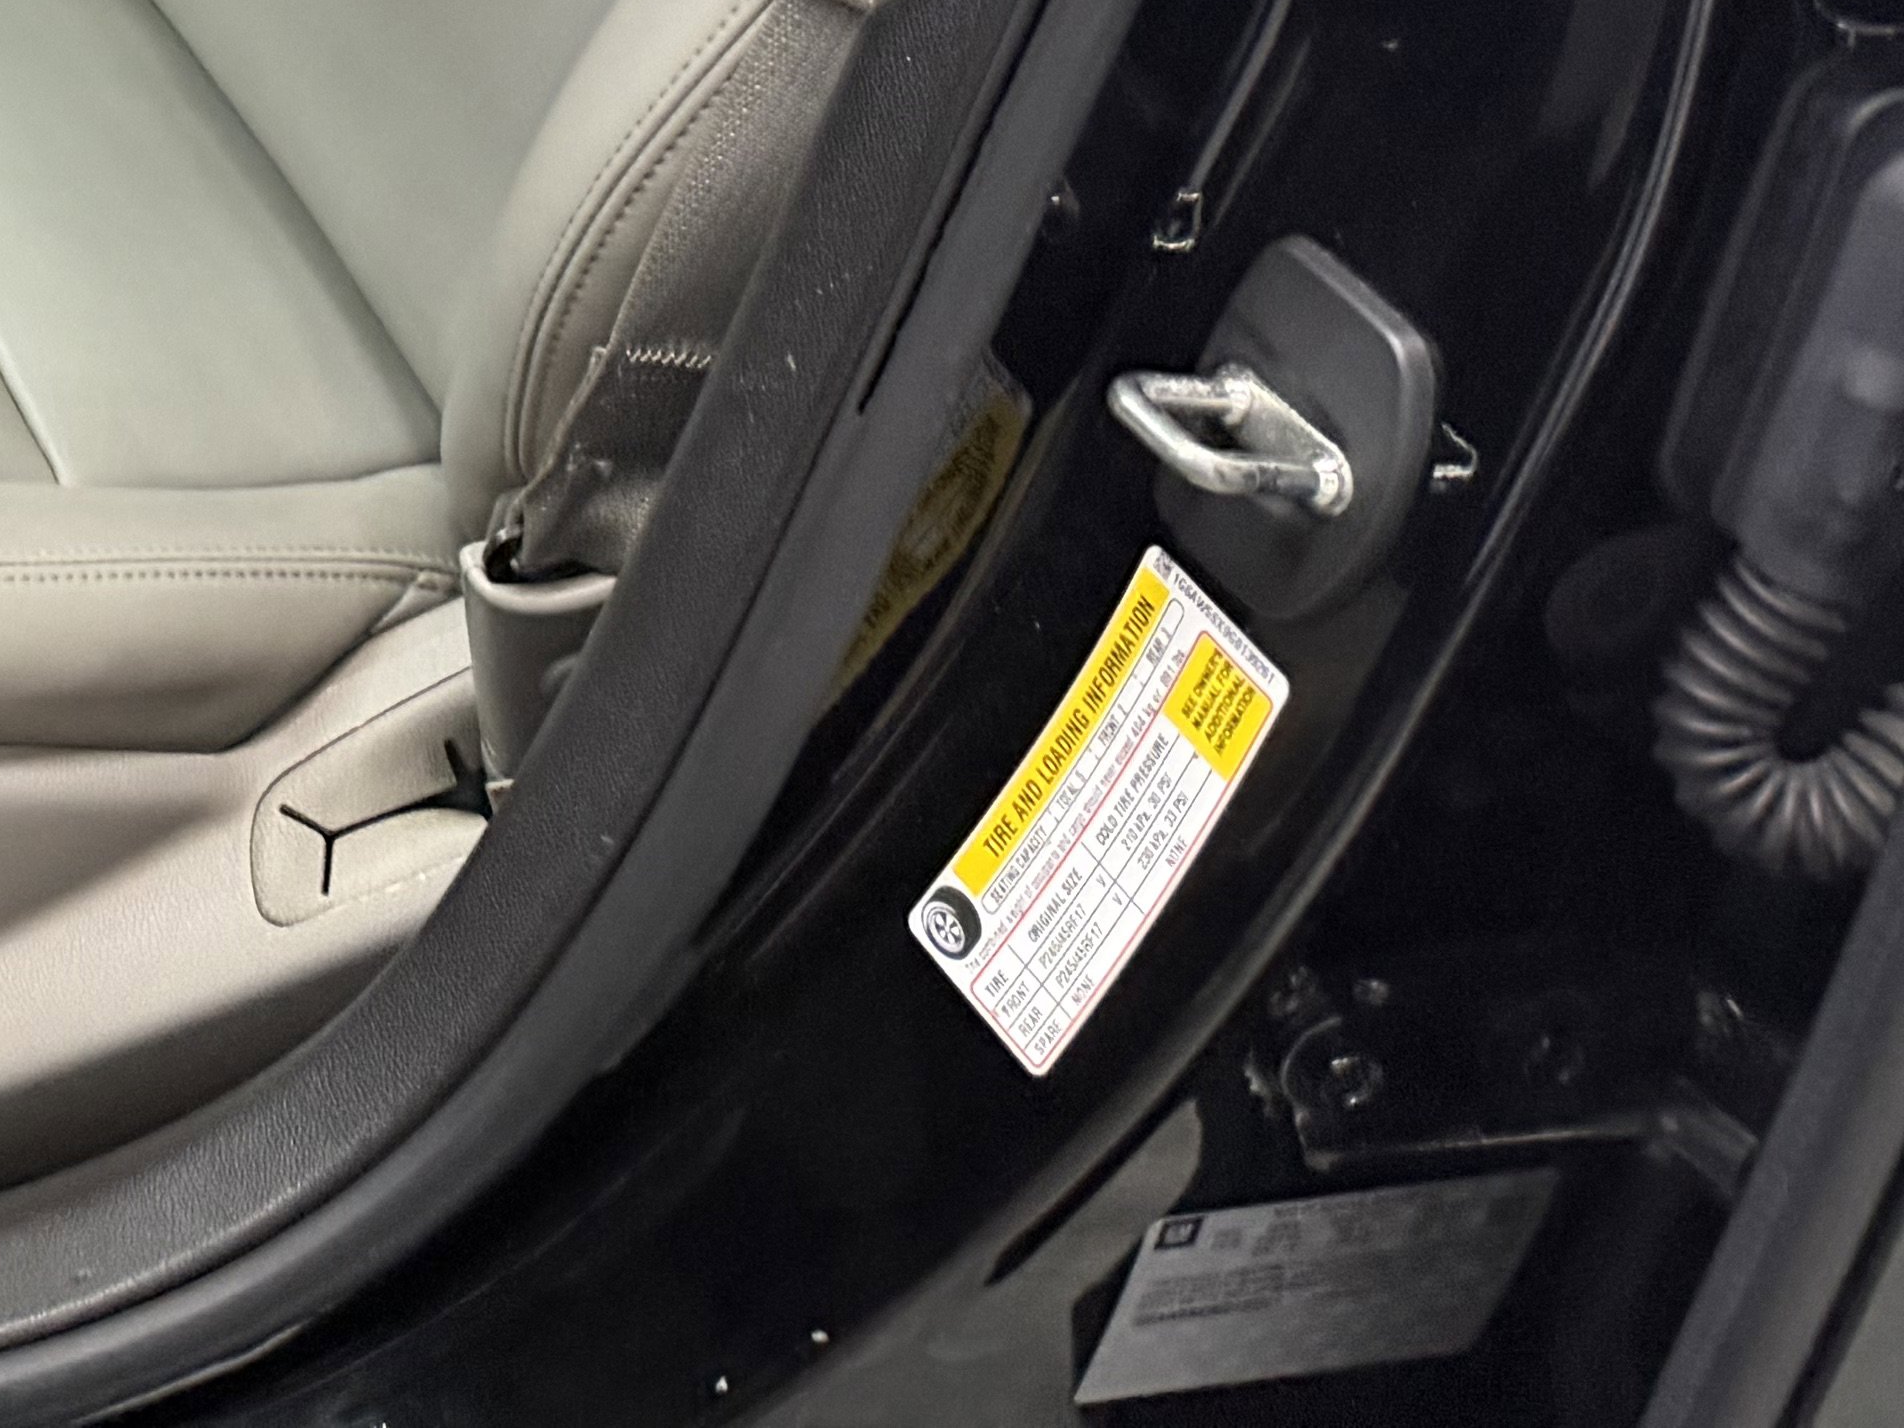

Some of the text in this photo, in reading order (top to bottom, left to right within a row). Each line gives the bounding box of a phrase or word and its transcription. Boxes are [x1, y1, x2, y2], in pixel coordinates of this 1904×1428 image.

[983, 814, 1018, 857] TIRE
[1012, 779, 1043, 823] AND
[1036, 708, 1090, 785] LOADING
[1082, 595, 1155, 714] INFORMATION
[1192, 660, 1234, 730] MANUAL FOR
[1204, 675, 1245, 743] ADDITIONAL
[1214, 686, 1256, 755] INFORMATION
[984, 969, 1009, 997] TIRE
[1028, 892, 1066, 943] ORIGINAL
[1061, 867, 1083, 896] SIZE
[1113, 788, 1135, 818] TIRE
[1130, 733, 1169, 793] PRESSURE
[1015, 825, 1047, 869] CAPACITY
[1018, 1006, 1043, 1037] REAR
[1034, 1019, 1061, 1055] SPARE
